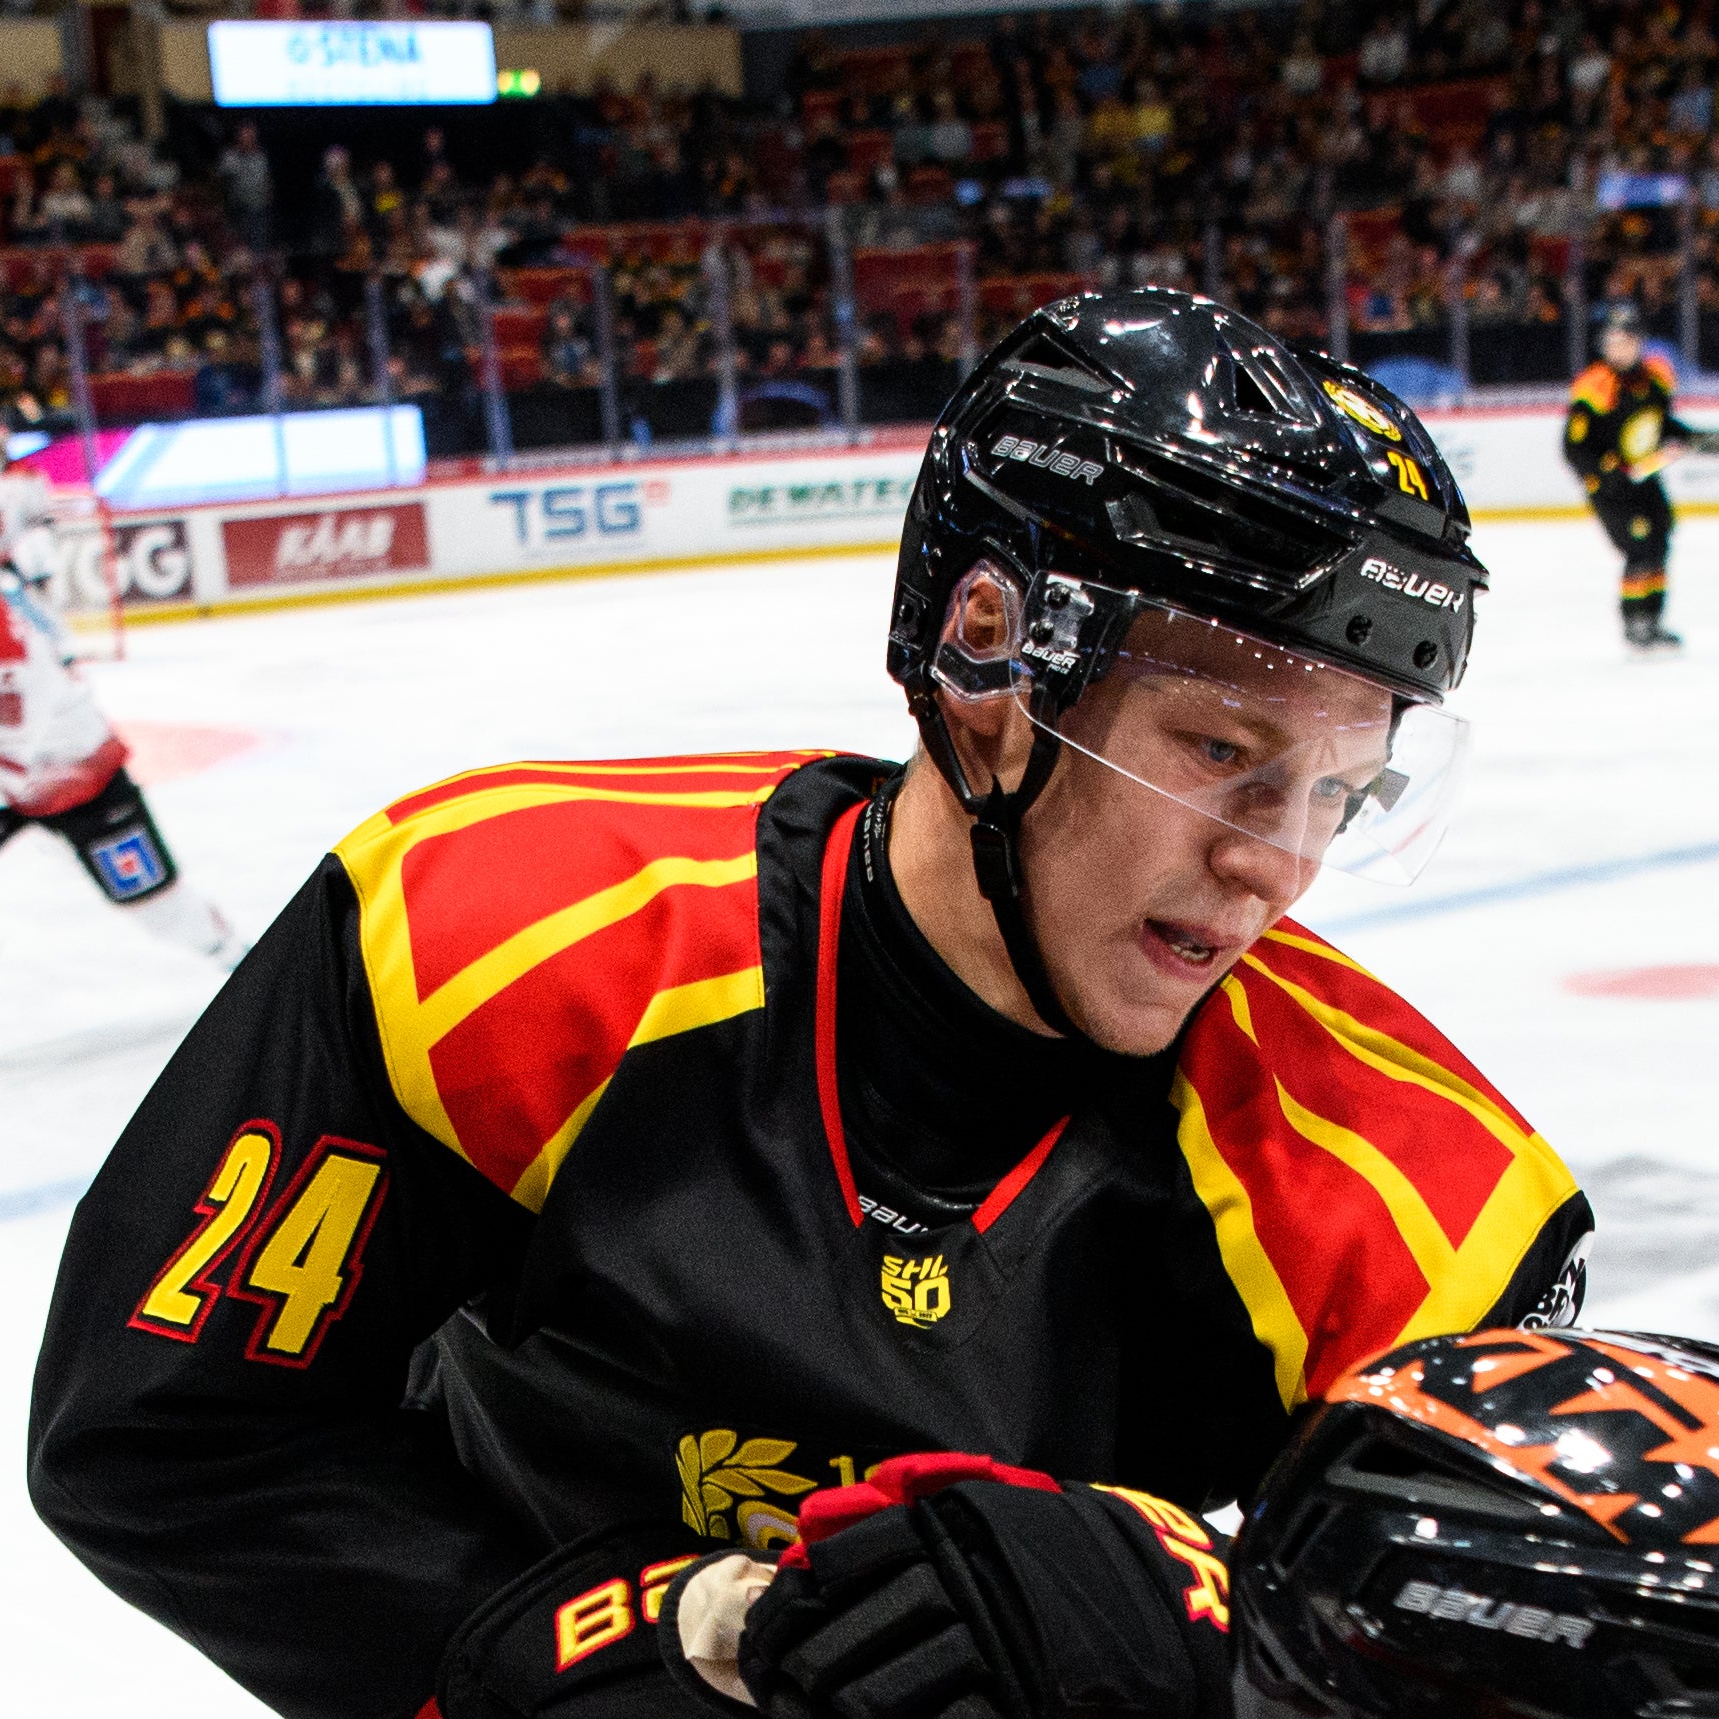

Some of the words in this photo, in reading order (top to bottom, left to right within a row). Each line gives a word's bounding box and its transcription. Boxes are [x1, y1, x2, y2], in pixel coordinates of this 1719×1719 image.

[990, 434, 1105, 486] BAUER
[1386, 450, 1429, 501] 24
[488, 480, 644, 547] TSG
[858, 1194, 929, 1234] BAU
[127, 1118, 390, 1369] 24
[881, 1271, 951, 1320] 50
[1394, 1580, 1597, 1650] BAUER
